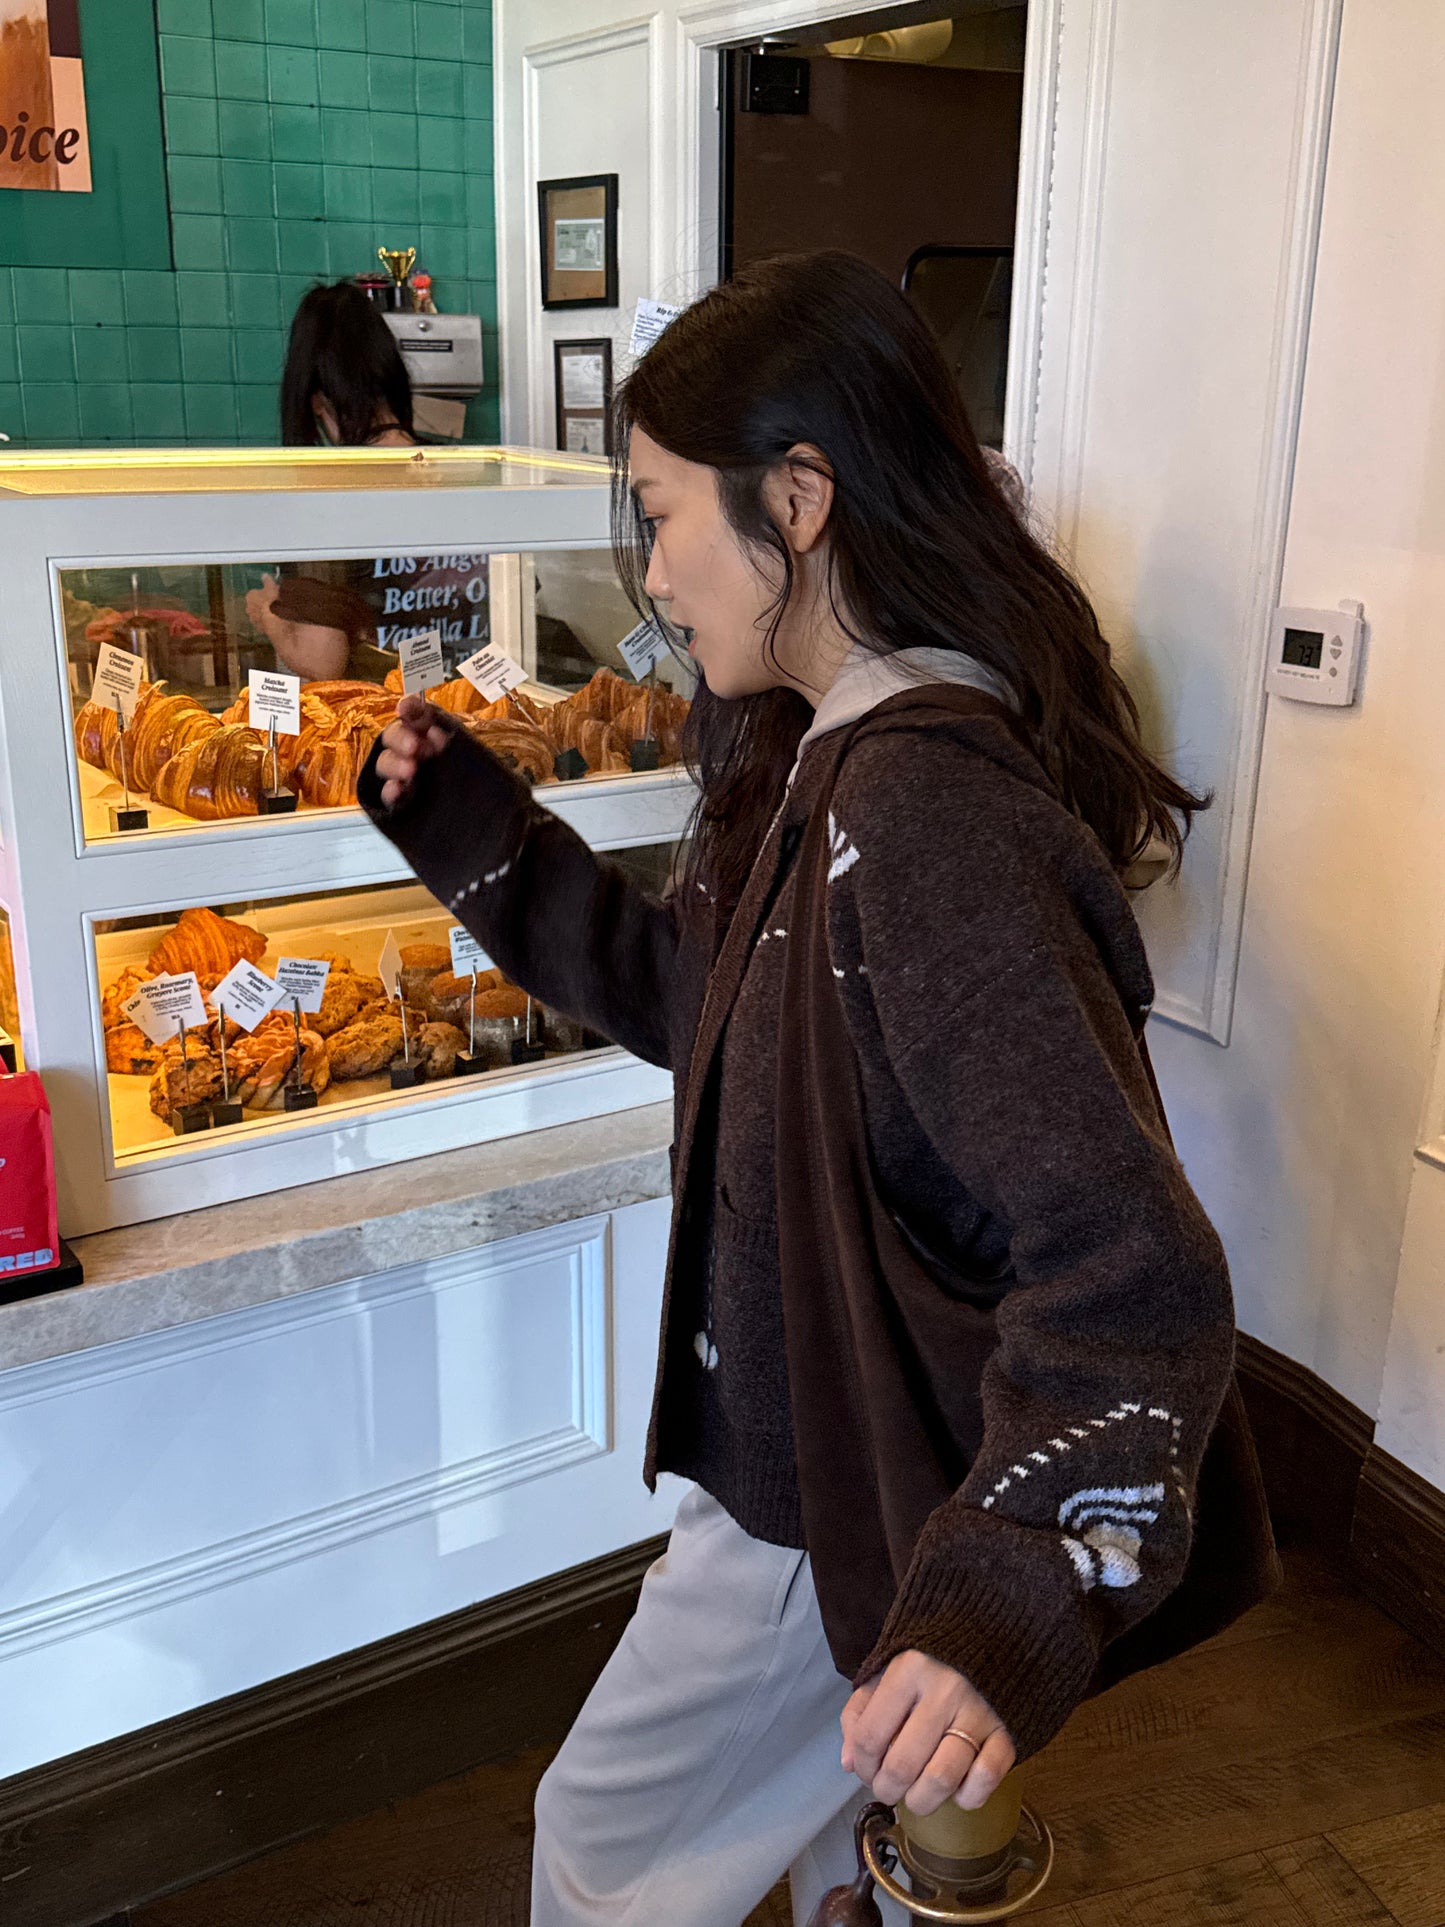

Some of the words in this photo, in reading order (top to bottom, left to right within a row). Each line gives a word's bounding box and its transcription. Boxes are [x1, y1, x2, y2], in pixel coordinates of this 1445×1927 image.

[0, 111, 80, 165] ice
[373, 557, 417, 578] Los
[383, 583, 459, 615] Better,
[376, 616, 464, 650] Vanilla
[109, 652, 134, 665] Cinnamon
[261, 684, 289, 694] Croissant
[264, 677, 286, 687] Matcha
[279, 967, 306, 976] Hazelnut
[305, 969, 325, 977] Babka
[289, 962, 318, 970] Chocolate
[140, 985, 160, 994] Olive,
[160, 978, 194, 989] Rosemary,
[246, 971, 274, 991] Blueberry
[247, 980, 264, 992] Scone
[146, 988, 173, 999] Gruyere
[173, 985, 192, 994] Scone
